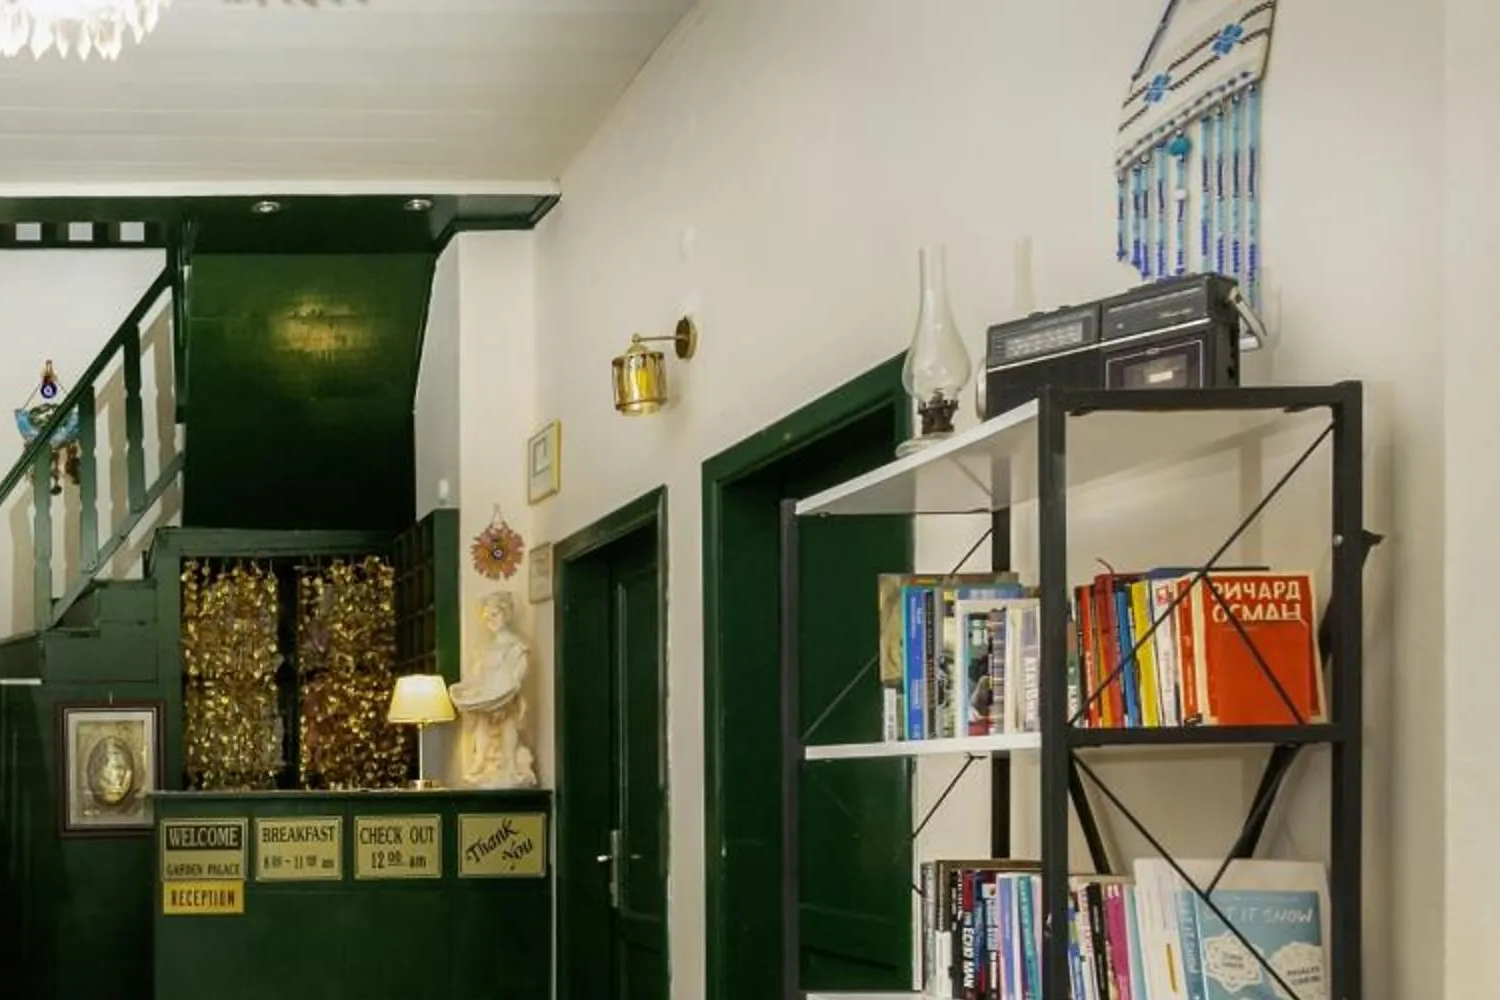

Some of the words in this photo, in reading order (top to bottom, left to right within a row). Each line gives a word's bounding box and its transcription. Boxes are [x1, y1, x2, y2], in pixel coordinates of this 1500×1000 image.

[1210, 580, 1302, 601] РИЧАРД
[168, 827, 240, 847] WELCOME
[262, 825, 335, 843] BREAKFAST
[360, 826, 403, 845] CHECK
[409, 826, 434, 845] OUT
[466, 817, 520, 864] Thank
[170, 889, 235, 907] RECEPTION
[1262, 906, 1315, 925] SNOW
[963, 960, 975, 989] MAN
